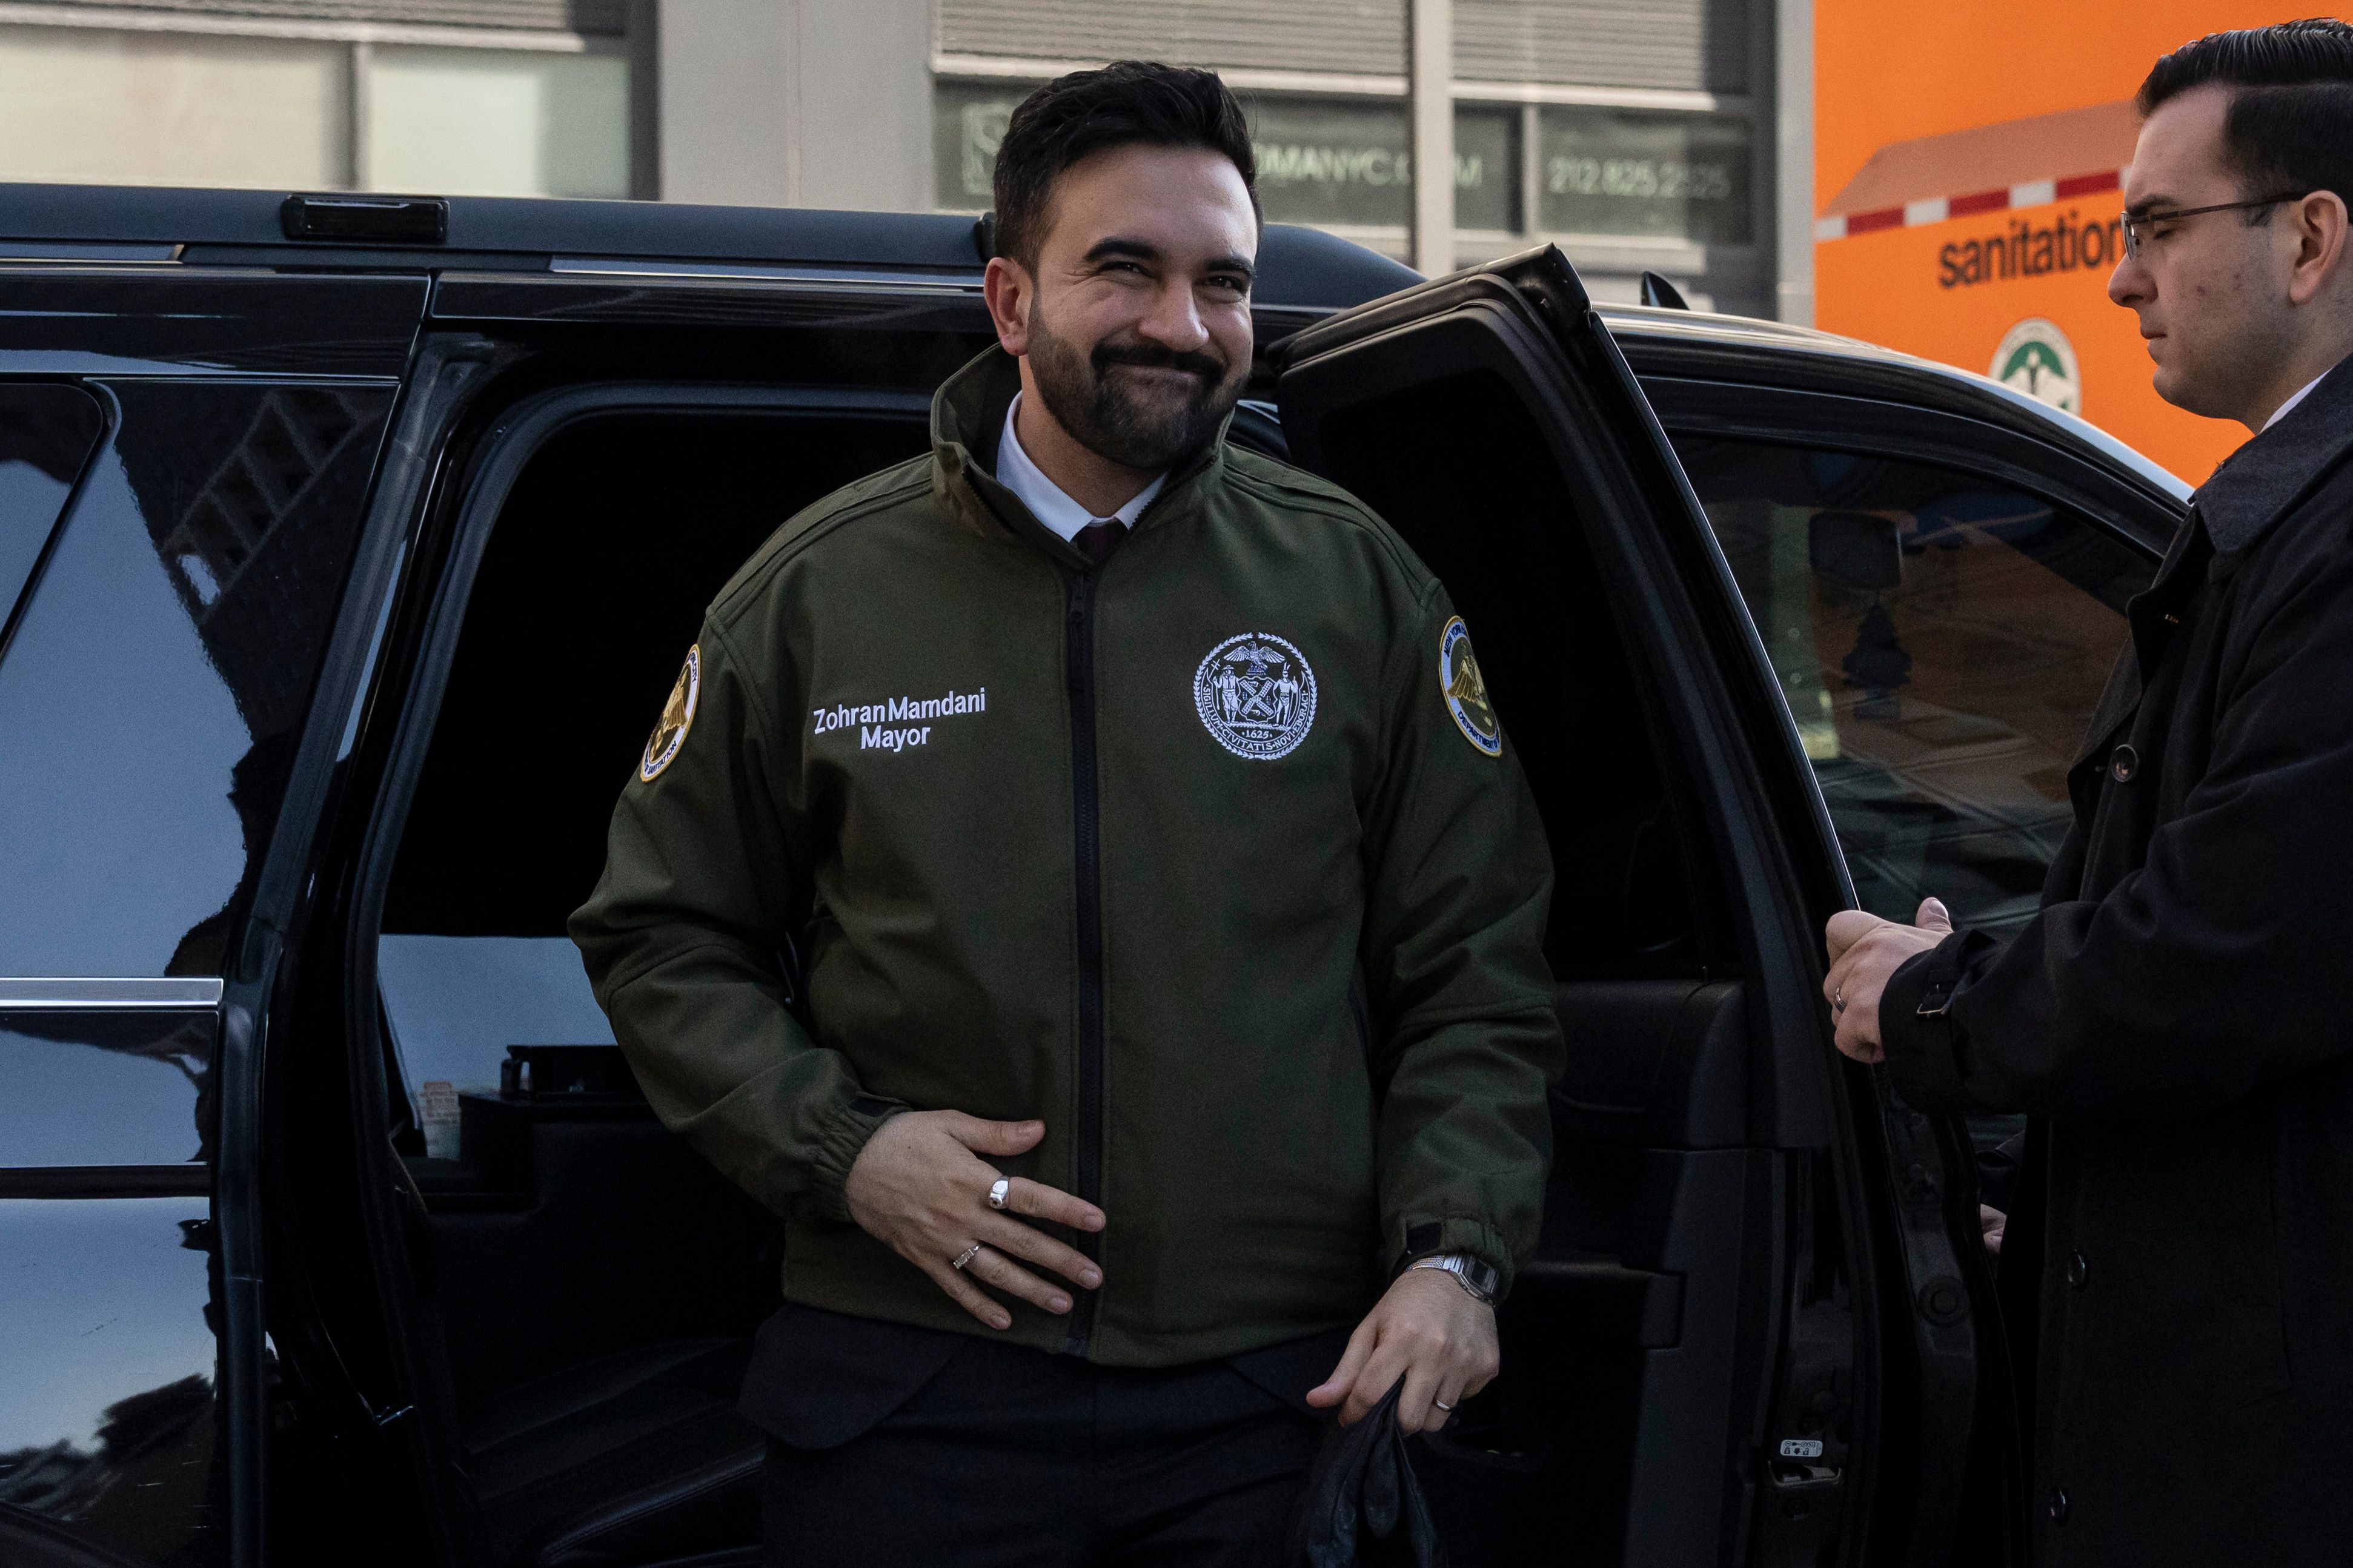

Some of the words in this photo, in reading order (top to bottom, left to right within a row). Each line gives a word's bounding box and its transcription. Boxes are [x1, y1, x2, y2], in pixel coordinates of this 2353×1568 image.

[1939, 210, 2125, 289] sanitation
[1444, 633, 1453, 658] NEW
[814, 704, 886, 735] Zohran
[888, 687, 986, 722] Mamdani
[1203, 686, 1221, 729] SIGILLUM
[1222, 729, 1273, 751] CIVITATIS
[1275, 732, 1294, 749] NOVI
[1294, 692, 1309, 733] EBORACI
[860, 725, 931, 752] Mayor
[1246, 730, 1269, 739] 1625
